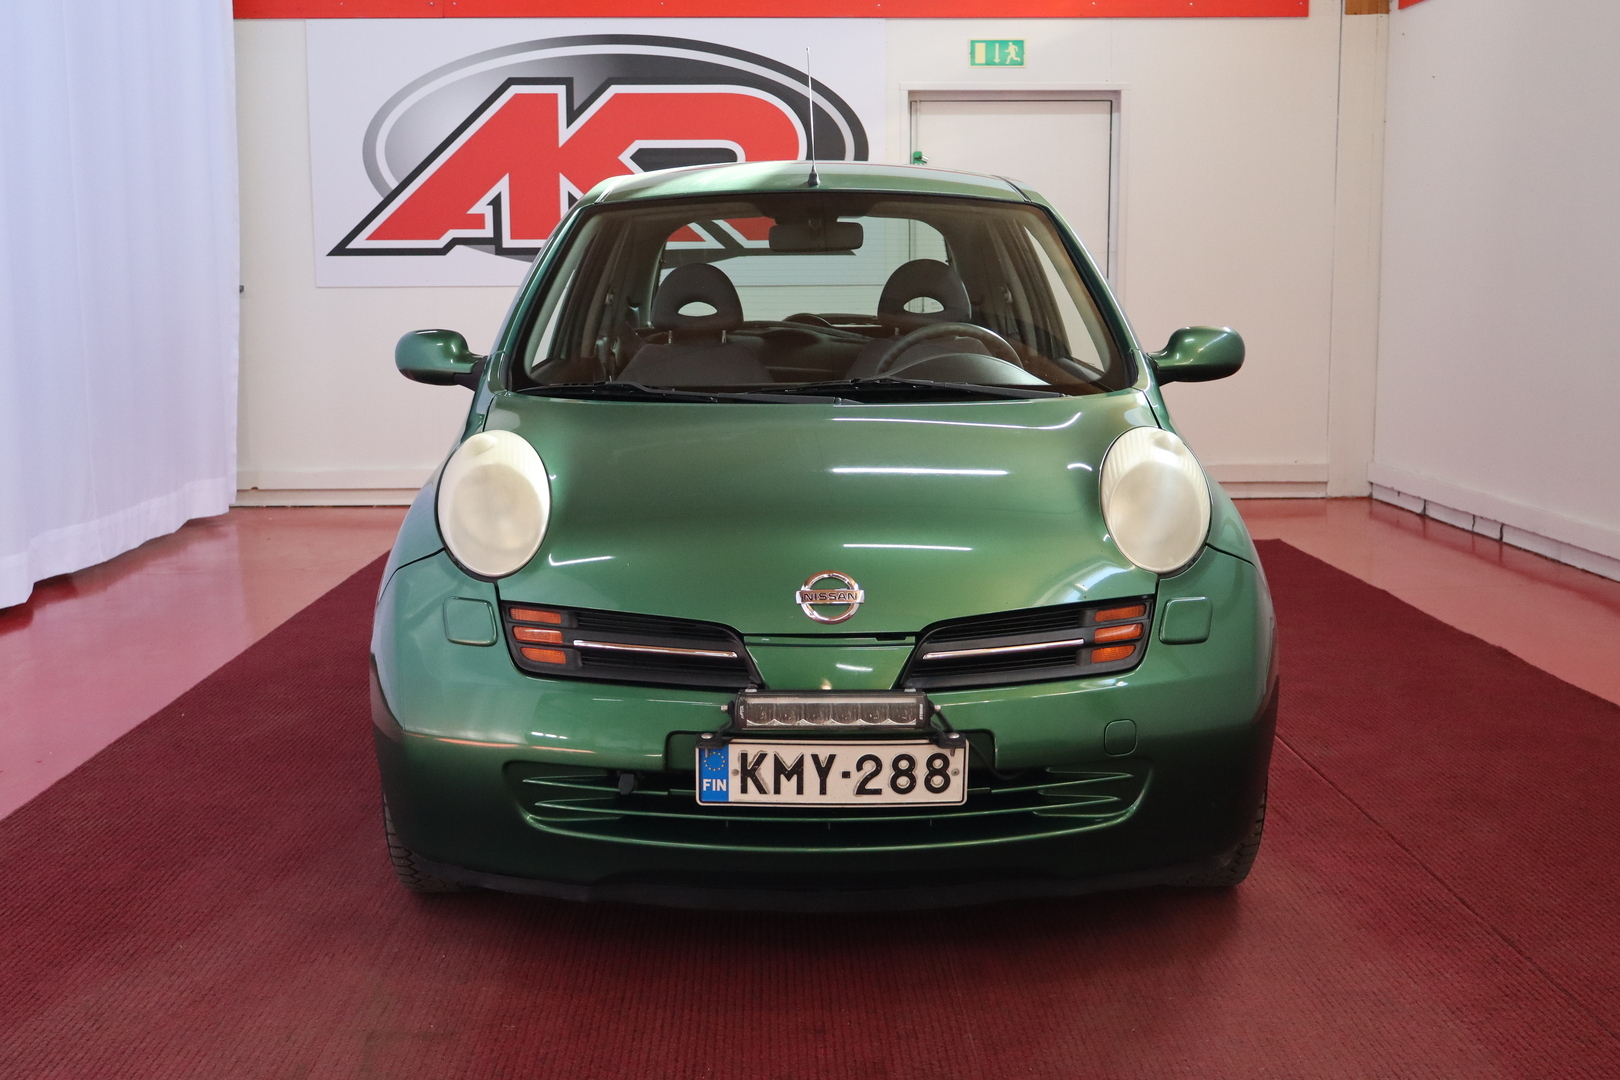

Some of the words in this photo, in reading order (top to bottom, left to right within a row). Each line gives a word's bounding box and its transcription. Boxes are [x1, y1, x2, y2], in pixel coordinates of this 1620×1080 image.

[803, 592, 858, 601] NISSAN
[739, 752, 951, 796] KMY-288
[702, 778, 727, 791] FIN
